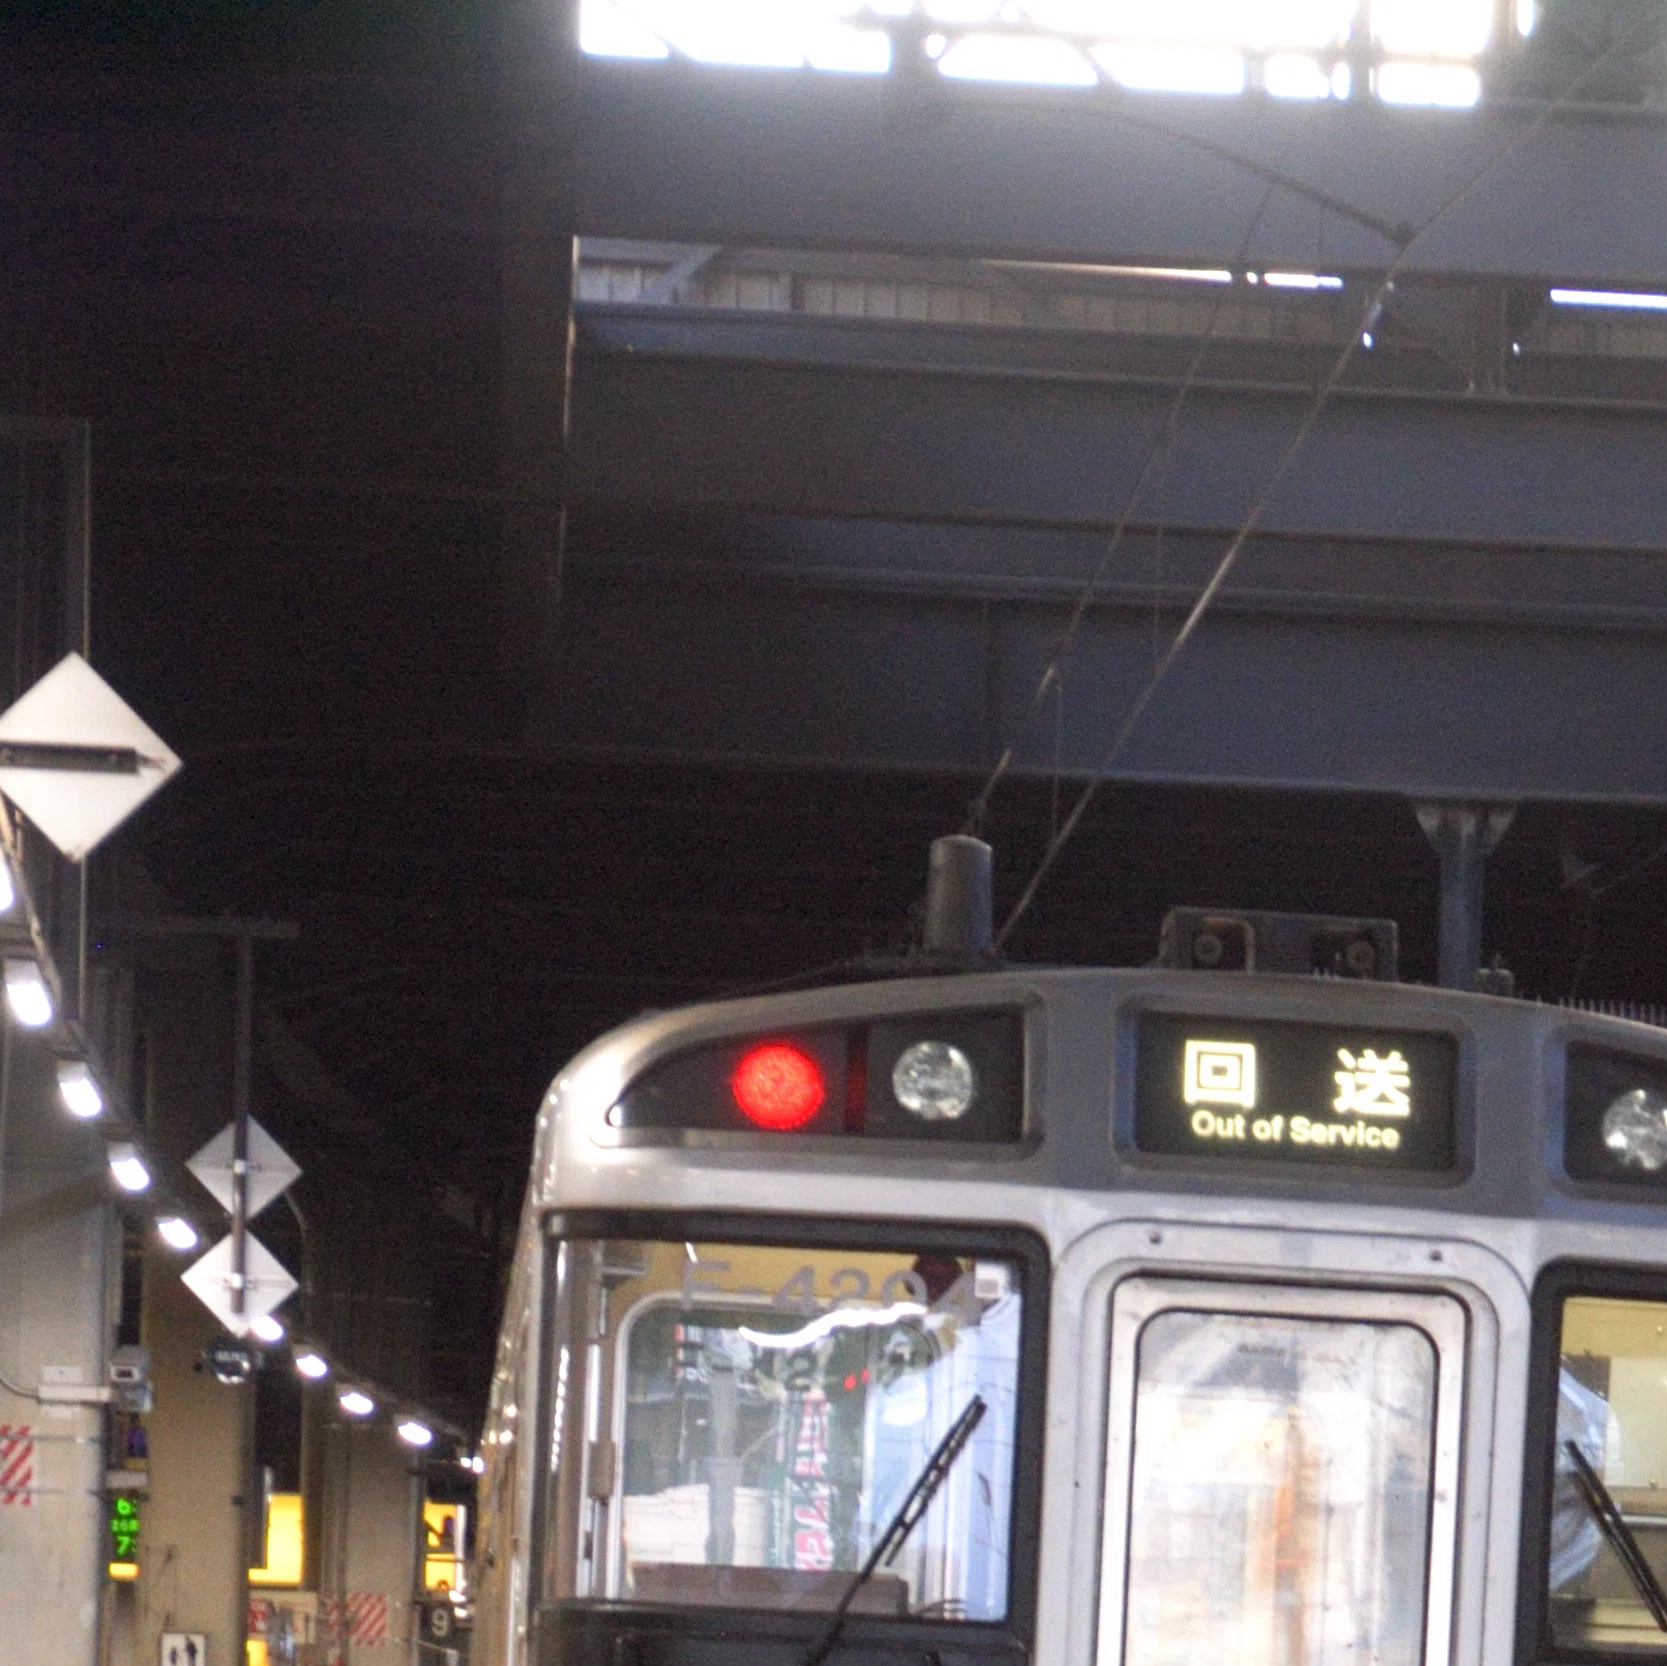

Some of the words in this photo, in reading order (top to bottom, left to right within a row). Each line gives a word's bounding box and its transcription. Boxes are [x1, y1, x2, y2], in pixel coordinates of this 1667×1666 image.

[1191, 1111, 1244, 1137] Out
[1253, 1114, 1281, 1140] of
[1290, 1117, 1400, 1148] Service
[431, 1608, 448, 1637] 9
